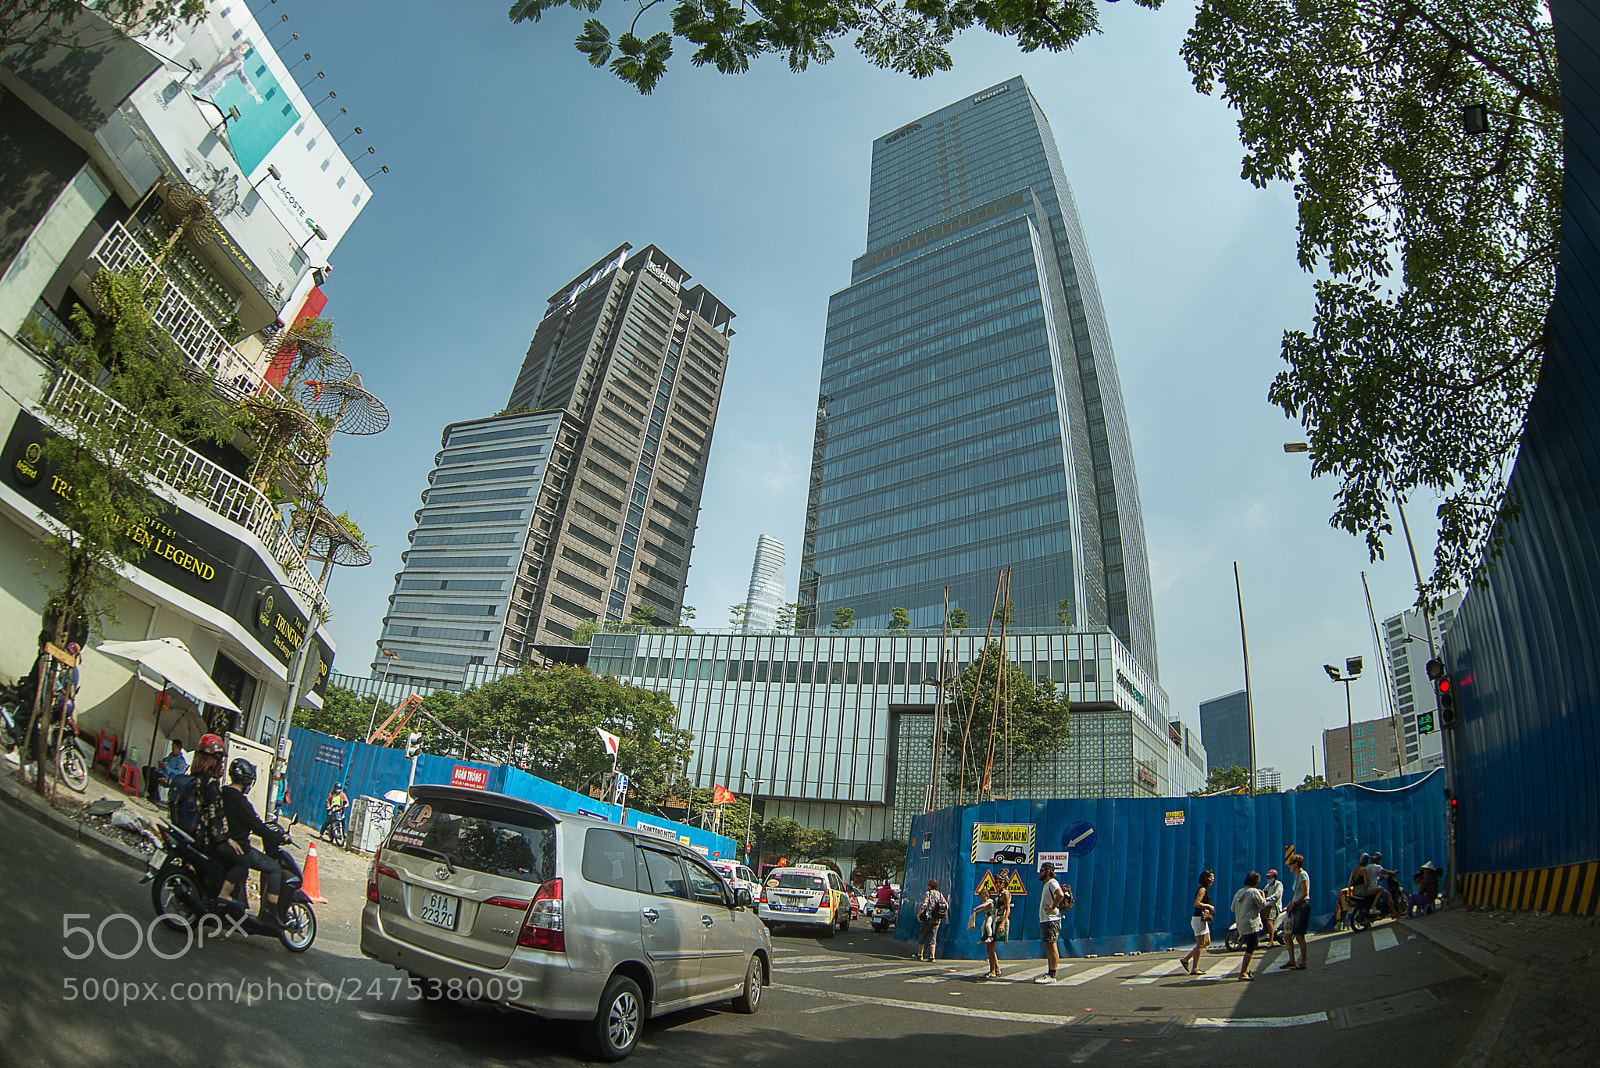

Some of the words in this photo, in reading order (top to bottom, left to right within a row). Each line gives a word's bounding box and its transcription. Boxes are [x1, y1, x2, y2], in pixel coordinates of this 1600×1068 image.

[974, 84, 1009, 104] Keppel
[276, 181, 306, 217] LACOSTE
[649, 262, 679, 293] Keppel
[153, 538, 215, 581] LEGEND
[430, 894, 448, 912] 61A
[421, 906, 454, 928] 223.70
